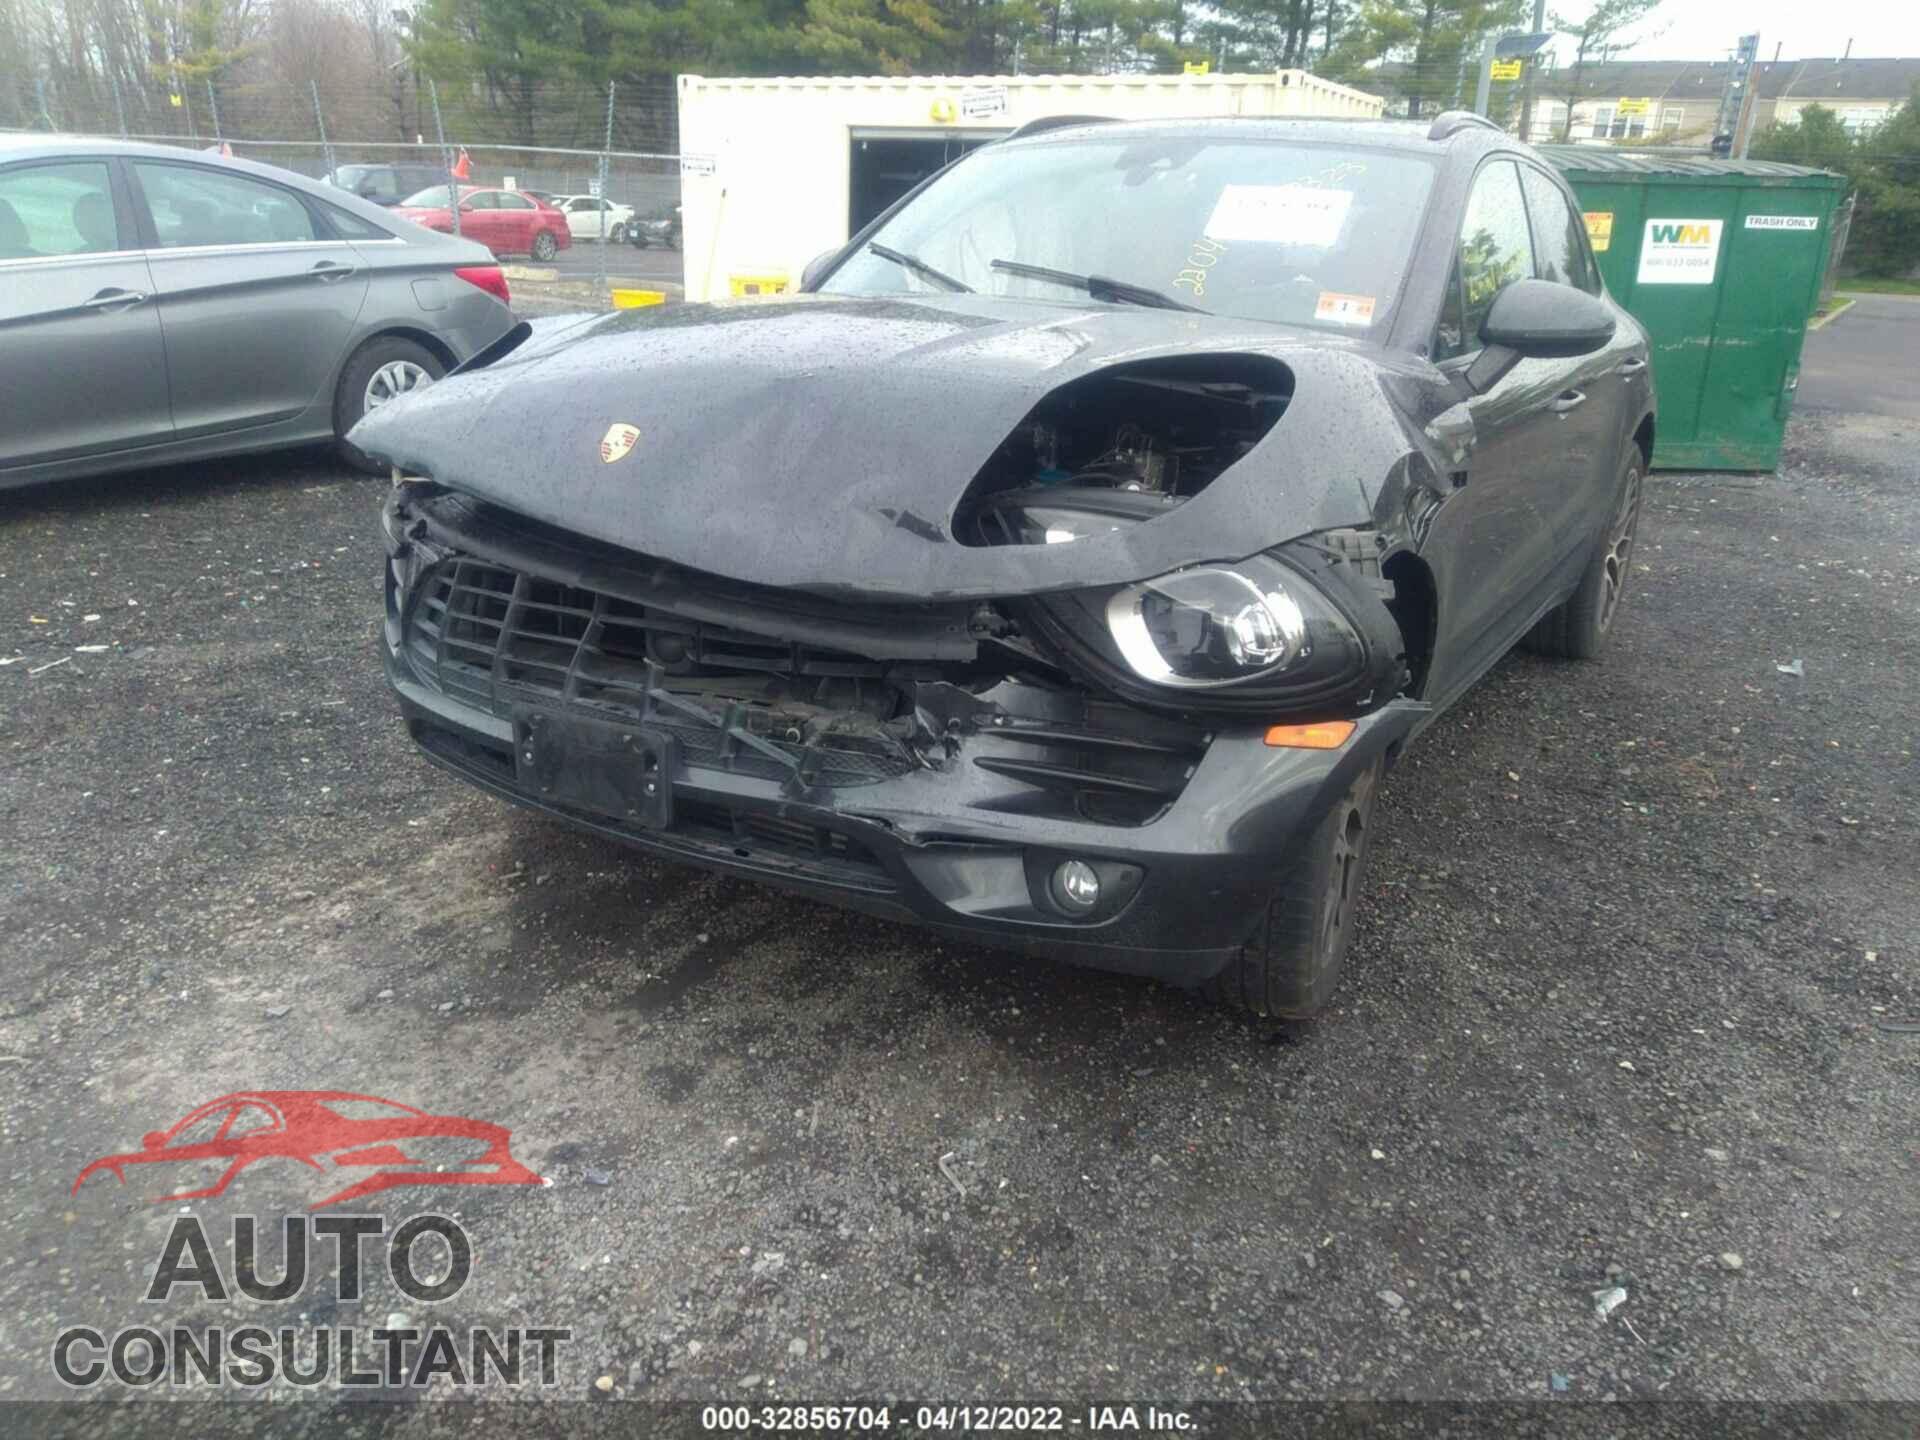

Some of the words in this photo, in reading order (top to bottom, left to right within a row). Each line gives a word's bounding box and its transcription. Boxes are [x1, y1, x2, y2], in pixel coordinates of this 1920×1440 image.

[1749, 217, 1784, 227] TRASH
[1786, 218, 1816, 228] ONLY
[1651, 224, 1711, 244] WM
